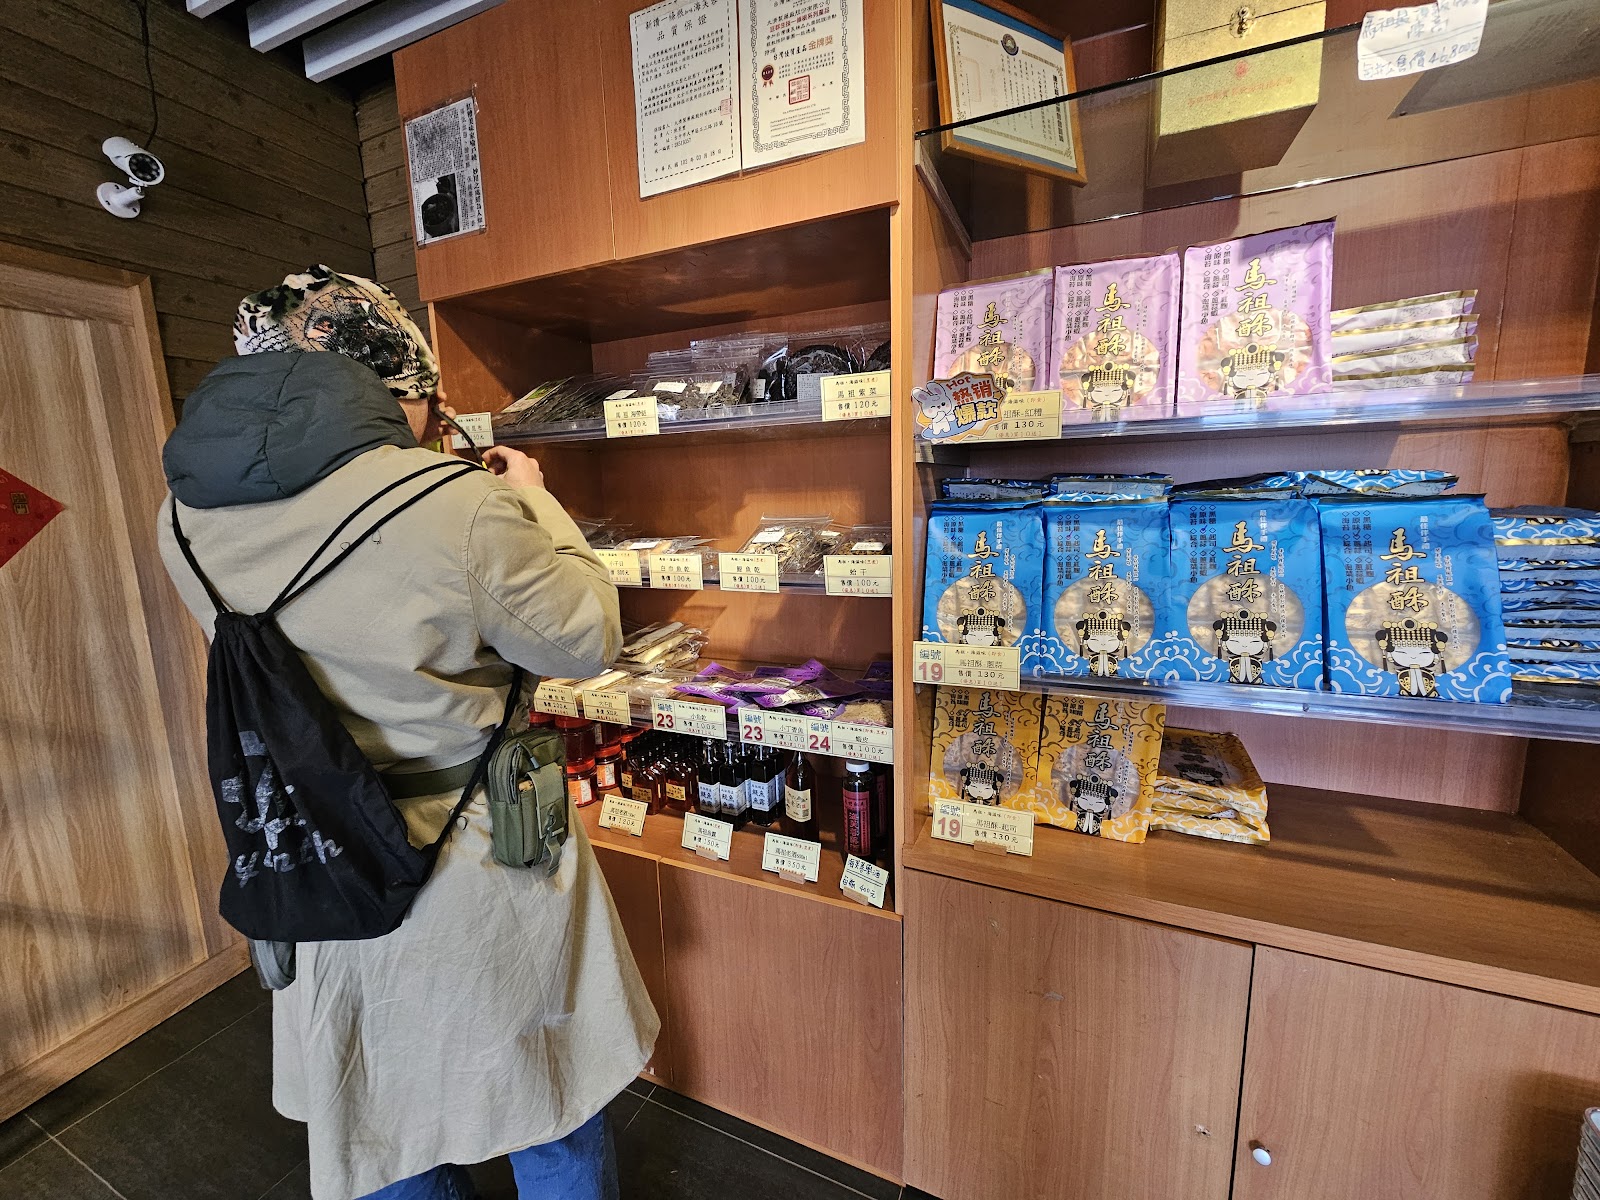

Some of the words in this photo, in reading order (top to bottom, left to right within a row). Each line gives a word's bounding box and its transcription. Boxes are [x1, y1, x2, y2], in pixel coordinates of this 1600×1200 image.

[656, 14, 707, 42] 品質保證
[808, 35, 834, 51] 金牌獎
[1233, 256, 1278, 338] 馬祖酥
[1093, 282, 1132, 357] 馬祖酥
[976, 301, 1009, 367] 馬祖酥
[837, 387, 877, 399] 馬祖紫菜
[951, 380, 993, 406] 热销
[854, 400, 878, 409] 120元
[953, 400, 998, 427] 爆款
[1014, 420, 1045, 430] 130元
[966, 529, 1000, 603] 馬祖酥
[1084, 528, 1121, 605] 馬祖酥
[1222, 519, 1266, 604] 馬祖酥
[1379, 527, 1430, 613] 馬祖酥
[856, 579, 880, 587] 100元
[919, 648, 942, 662] 編號
[918, 661, 943, 682] 19
[977, 670, 1005, 680] 130元
[656, 713, 675, 729] 23
[970, 691, 1002, 758] 馬祖酥
[743, 724, 764, 742] 23
[809, 734, 831, 752] 24
[1083, 701, 1120, 772] 馬祖酥
[858, 745, 885, 756] 100元
[938, 817, 961, 839] 19
[787, 861, 808, 872] 350元
